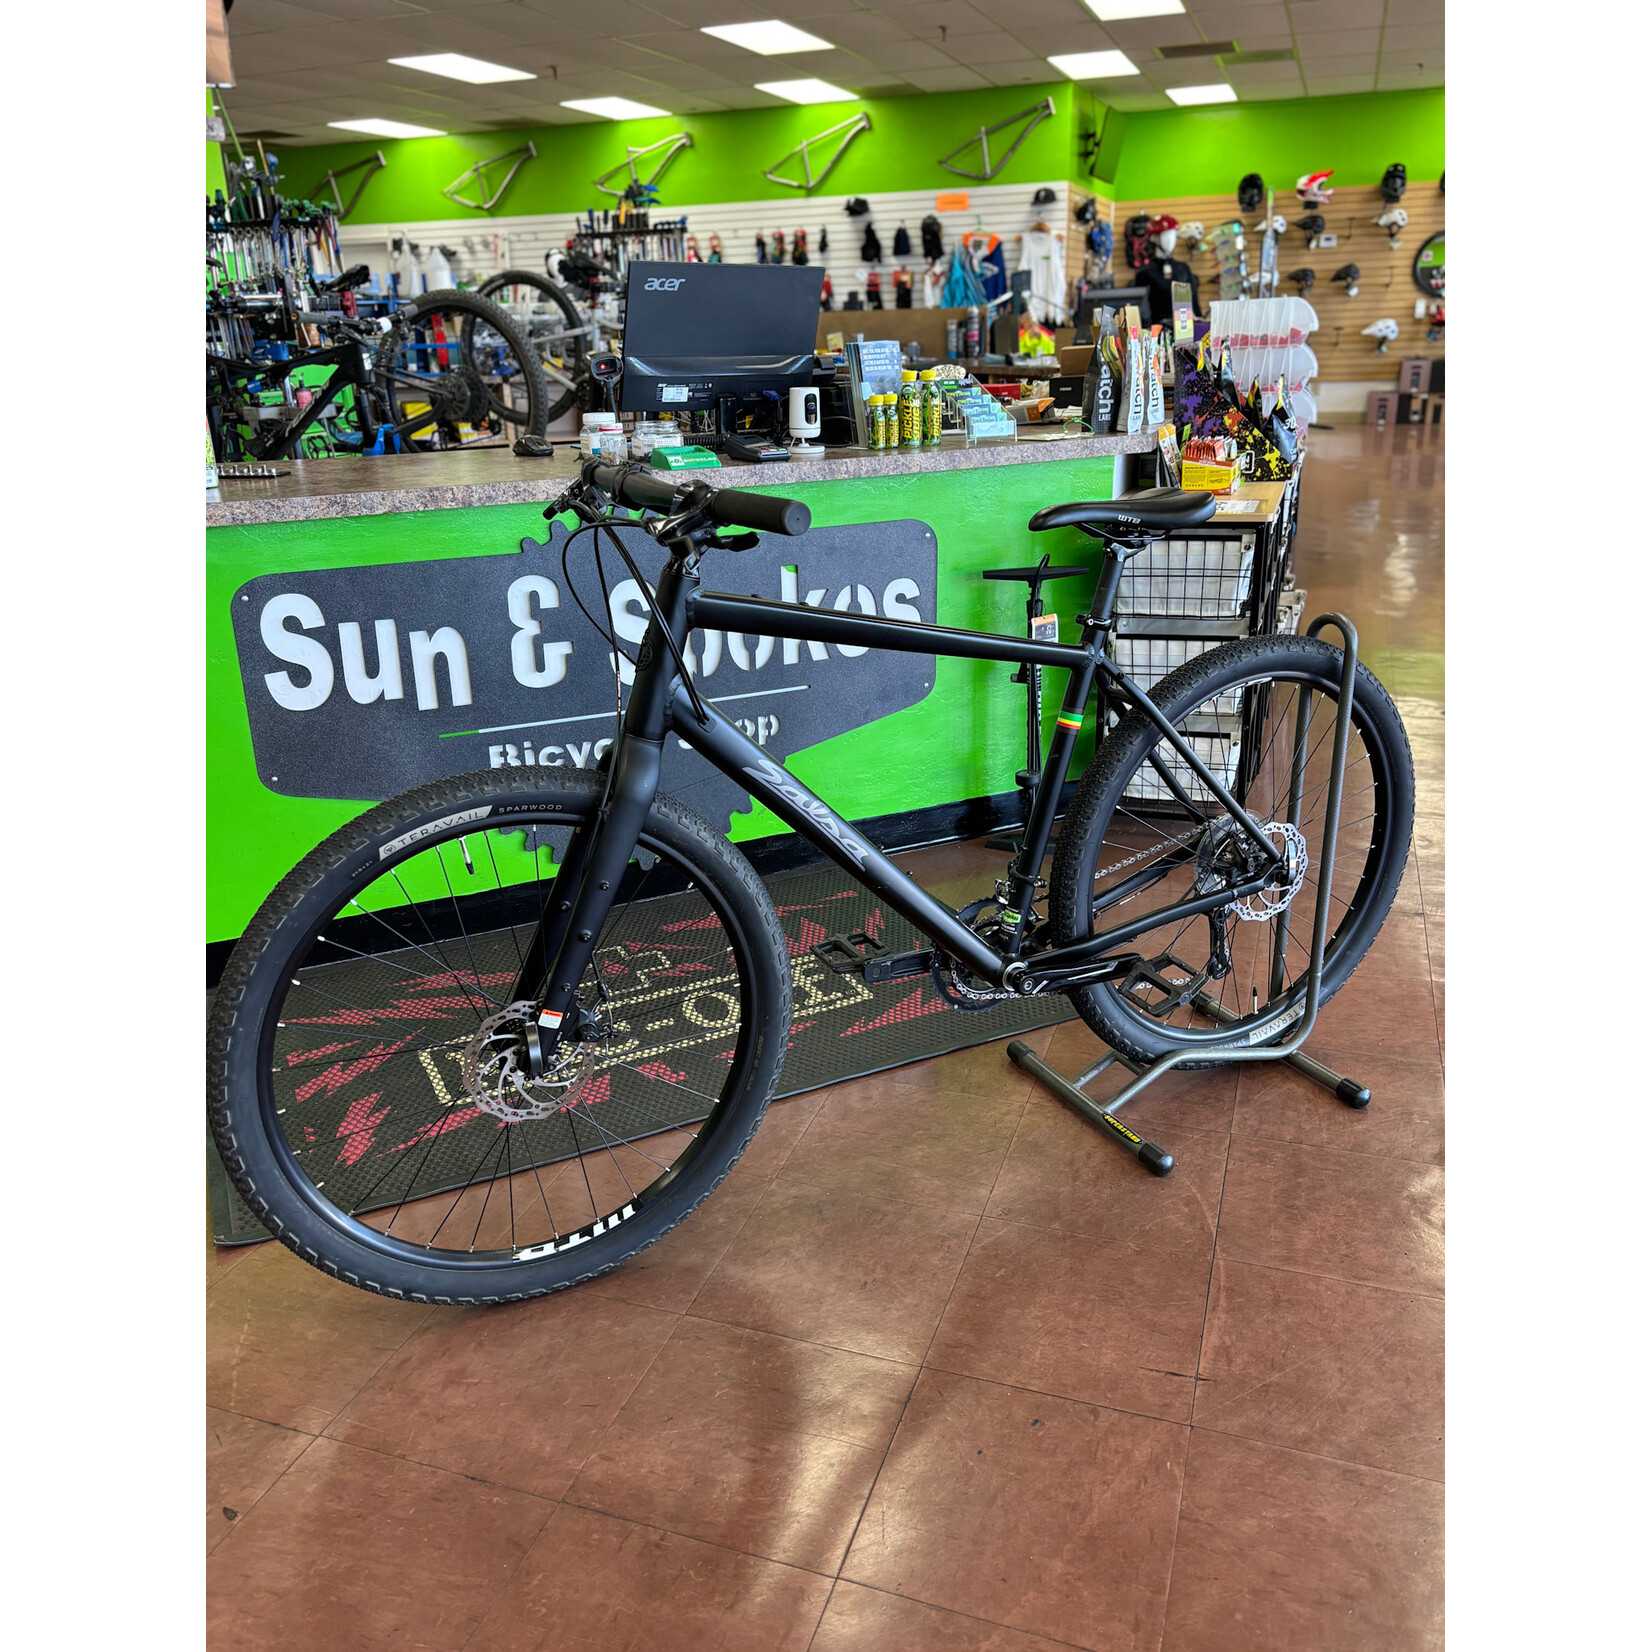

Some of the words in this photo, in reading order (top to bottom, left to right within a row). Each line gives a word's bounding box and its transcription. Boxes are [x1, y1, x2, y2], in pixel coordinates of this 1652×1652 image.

[644, 277, 686, 291] acer
[903, 399, 912, 439] PICKLE
[912, 399, 920, 438] JUICE
[1117, 514, 1142, 525] WTB
[260, 593, 473, 711] Sun
[507, 575, 574, 688] &
[498, 804, 563, 814] SPARWOOD
[741, 759, 869, 872] Salsa
[397, 811, 484, 847] TERAVAIL
[1251, 1008, 1300, 1041] TERAVAIL
